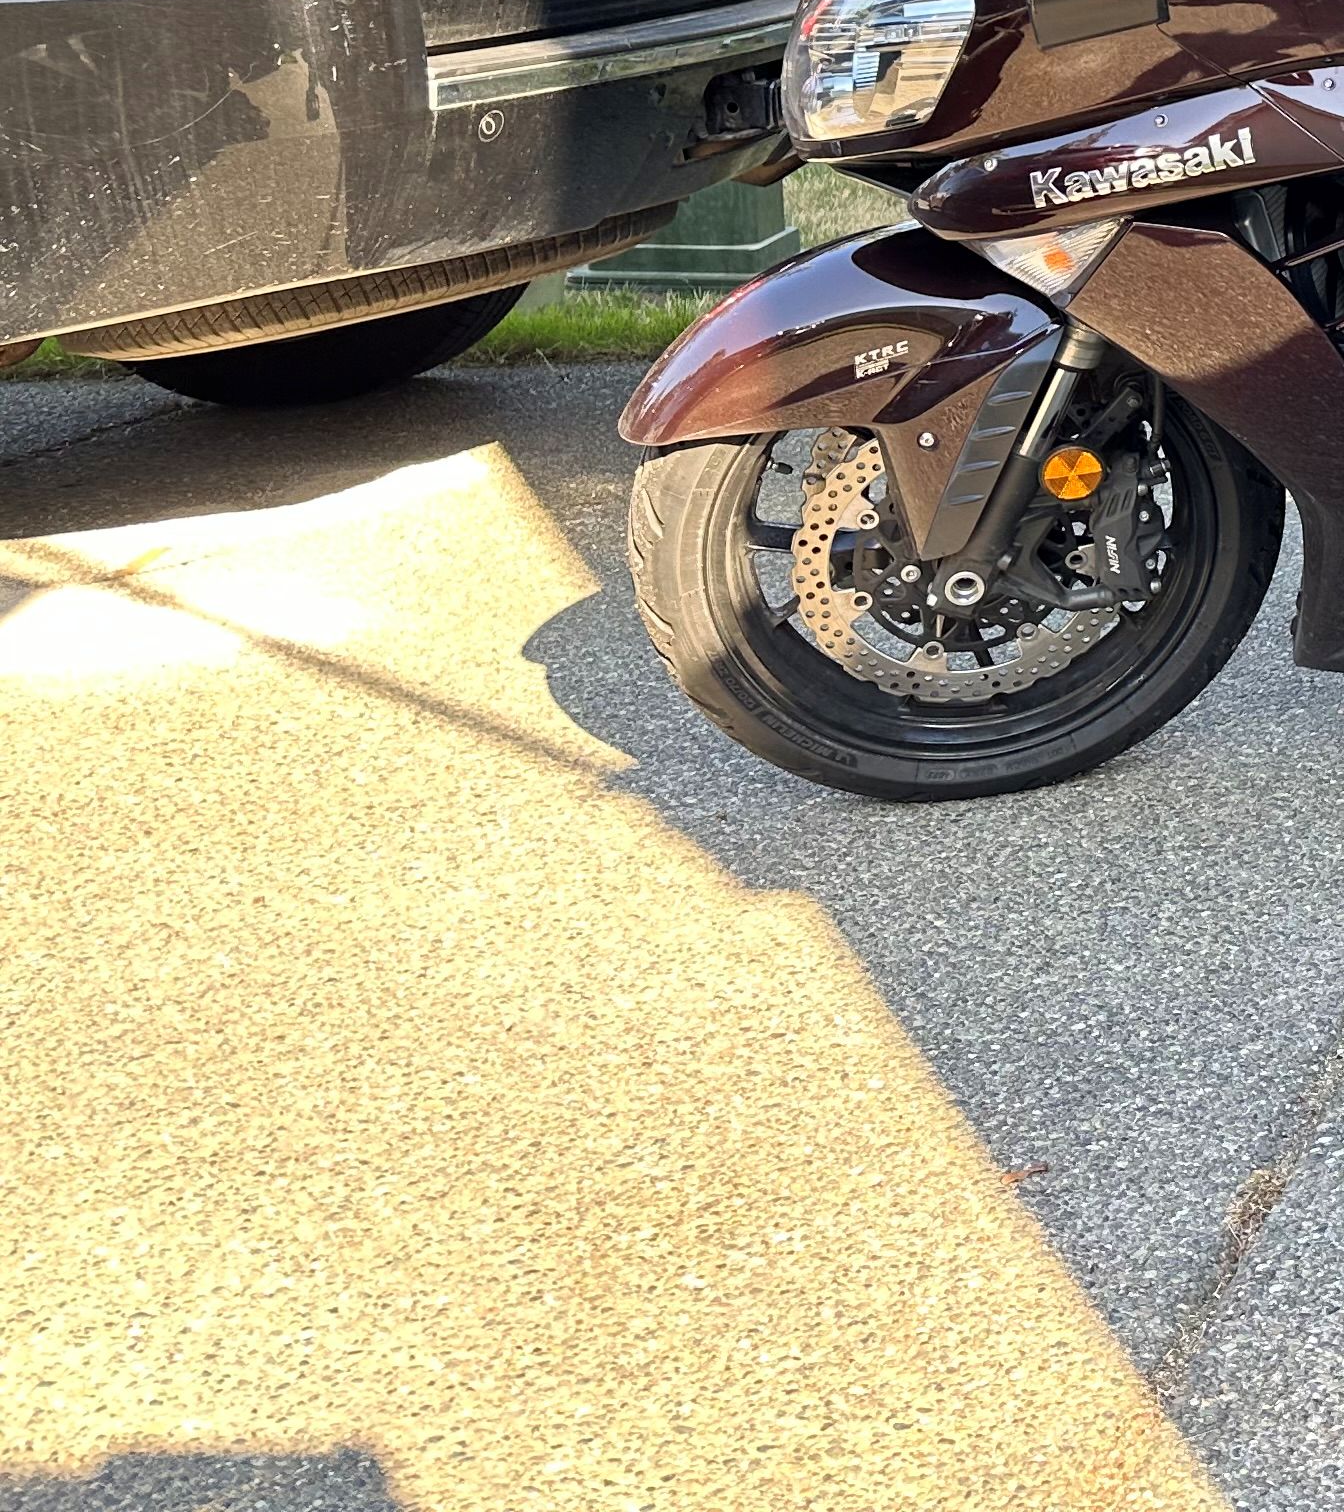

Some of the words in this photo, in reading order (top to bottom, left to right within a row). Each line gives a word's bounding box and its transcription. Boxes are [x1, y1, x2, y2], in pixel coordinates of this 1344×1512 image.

[1029, 126, 1257, 209] Kawasaki
[855, 340, 909, 365] KTRC
[1105, 535, 1121, 575] NISSIN
[762, 713, 832, 757] MICHELIN
